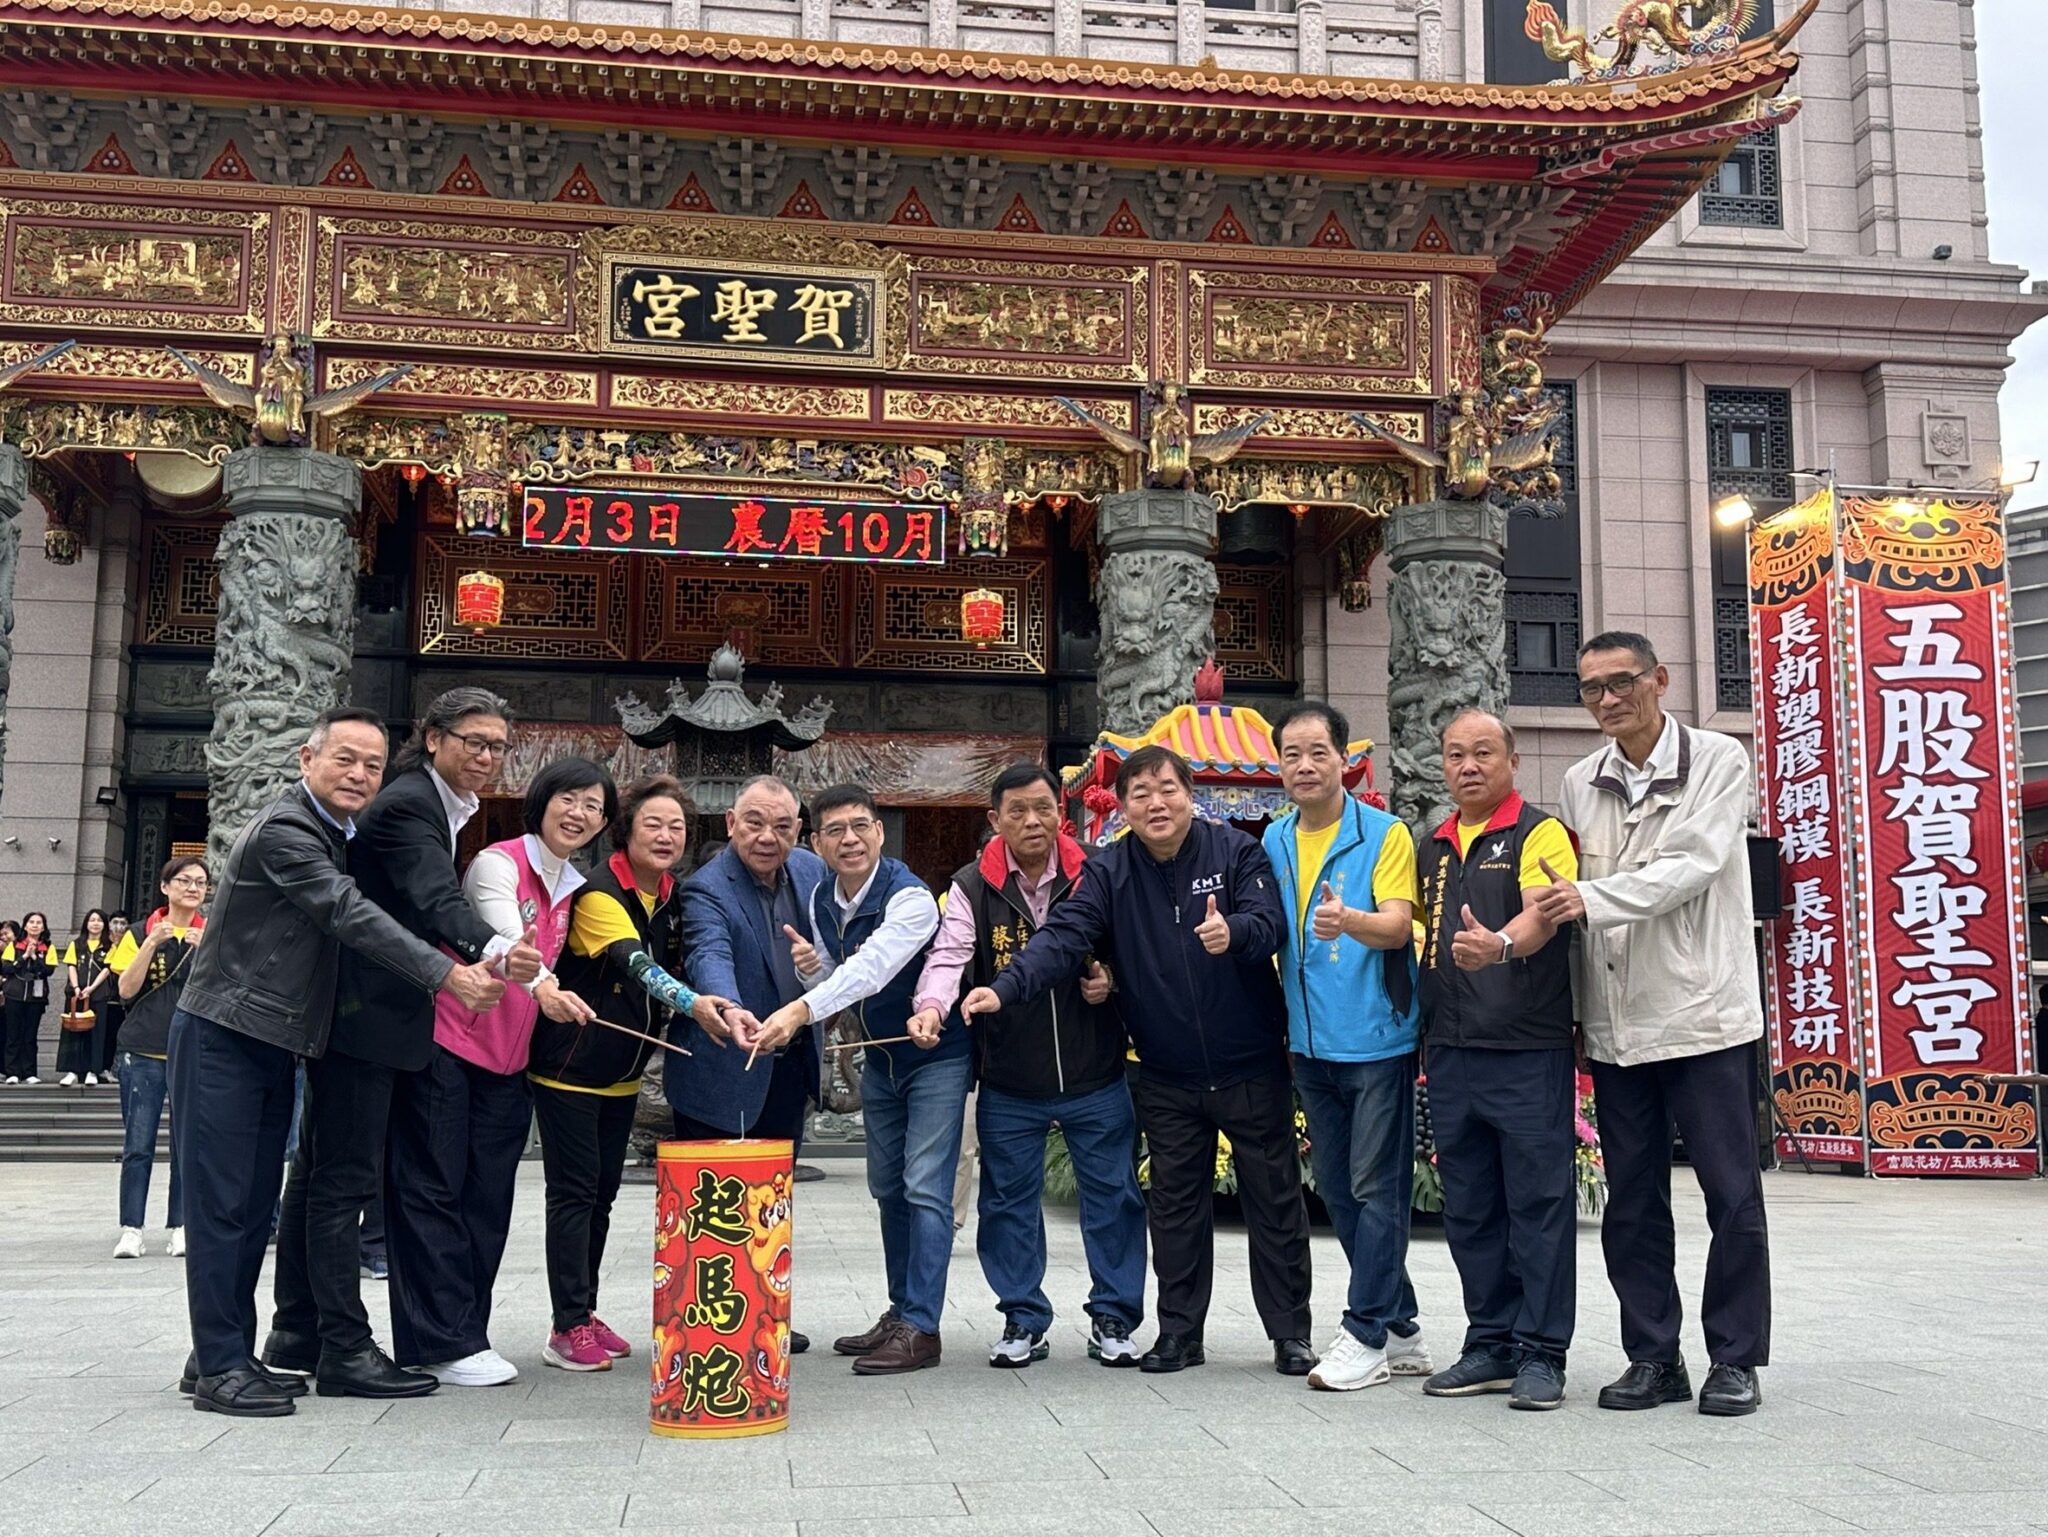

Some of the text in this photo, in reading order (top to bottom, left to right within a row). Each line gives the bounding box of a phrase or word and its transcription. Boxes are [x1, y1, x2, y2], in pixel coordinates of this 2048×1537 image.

[632, 276, 855, 349] 賀聖宮
[526, 497, 934, 560] 2月3日 農曆10月
[1192, 872, 1223, 890] KMT
[1768, 602, 1844, 1055] 長新塑膠鋼模 長新技研
[1872, 603, 1998, 1064] 五股賀聖宮
[682, 1167, 754, 1418] 起馬炮
